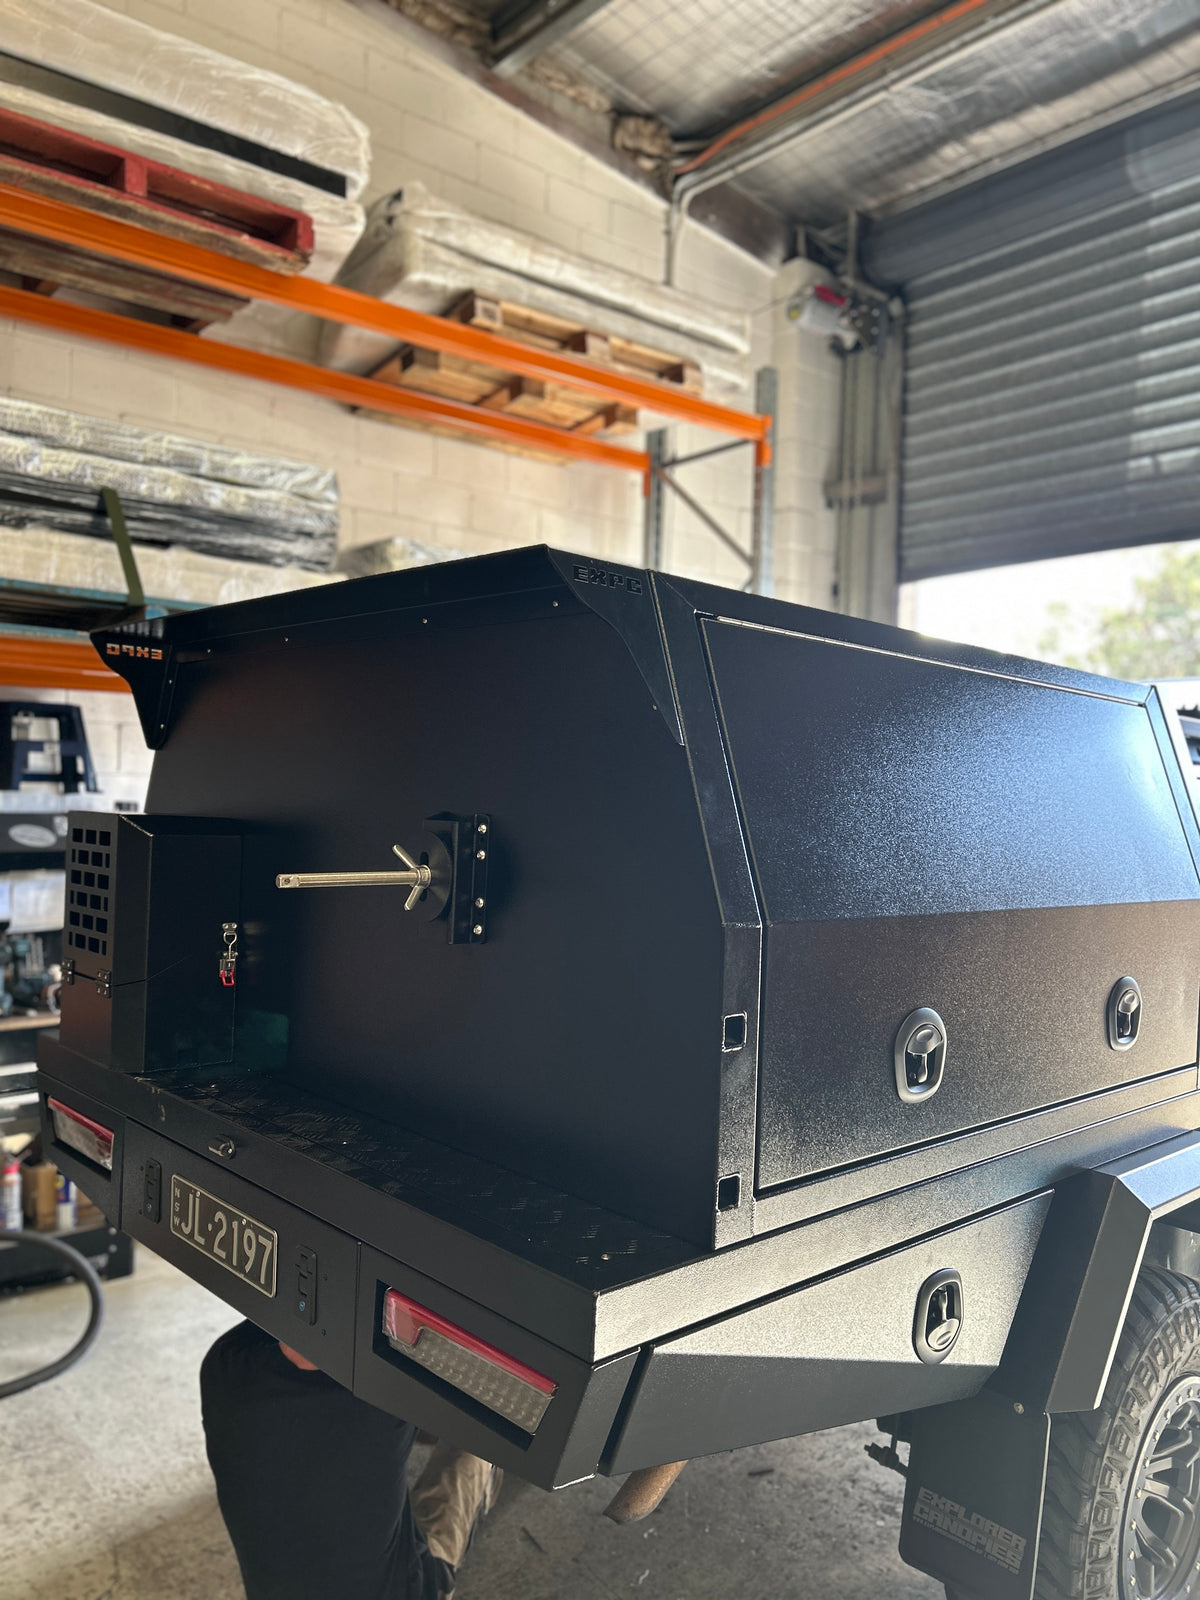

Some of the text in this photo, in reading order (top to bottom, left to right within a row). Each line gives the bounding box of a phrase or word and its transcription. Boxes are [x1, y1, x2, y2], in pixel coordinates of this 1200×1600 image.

[572, 564, 642, 595] EXPC
[913, 1504, 1024, 1570] CANOPIES
[917, 1486, 1027, 1552] EXPLORER
